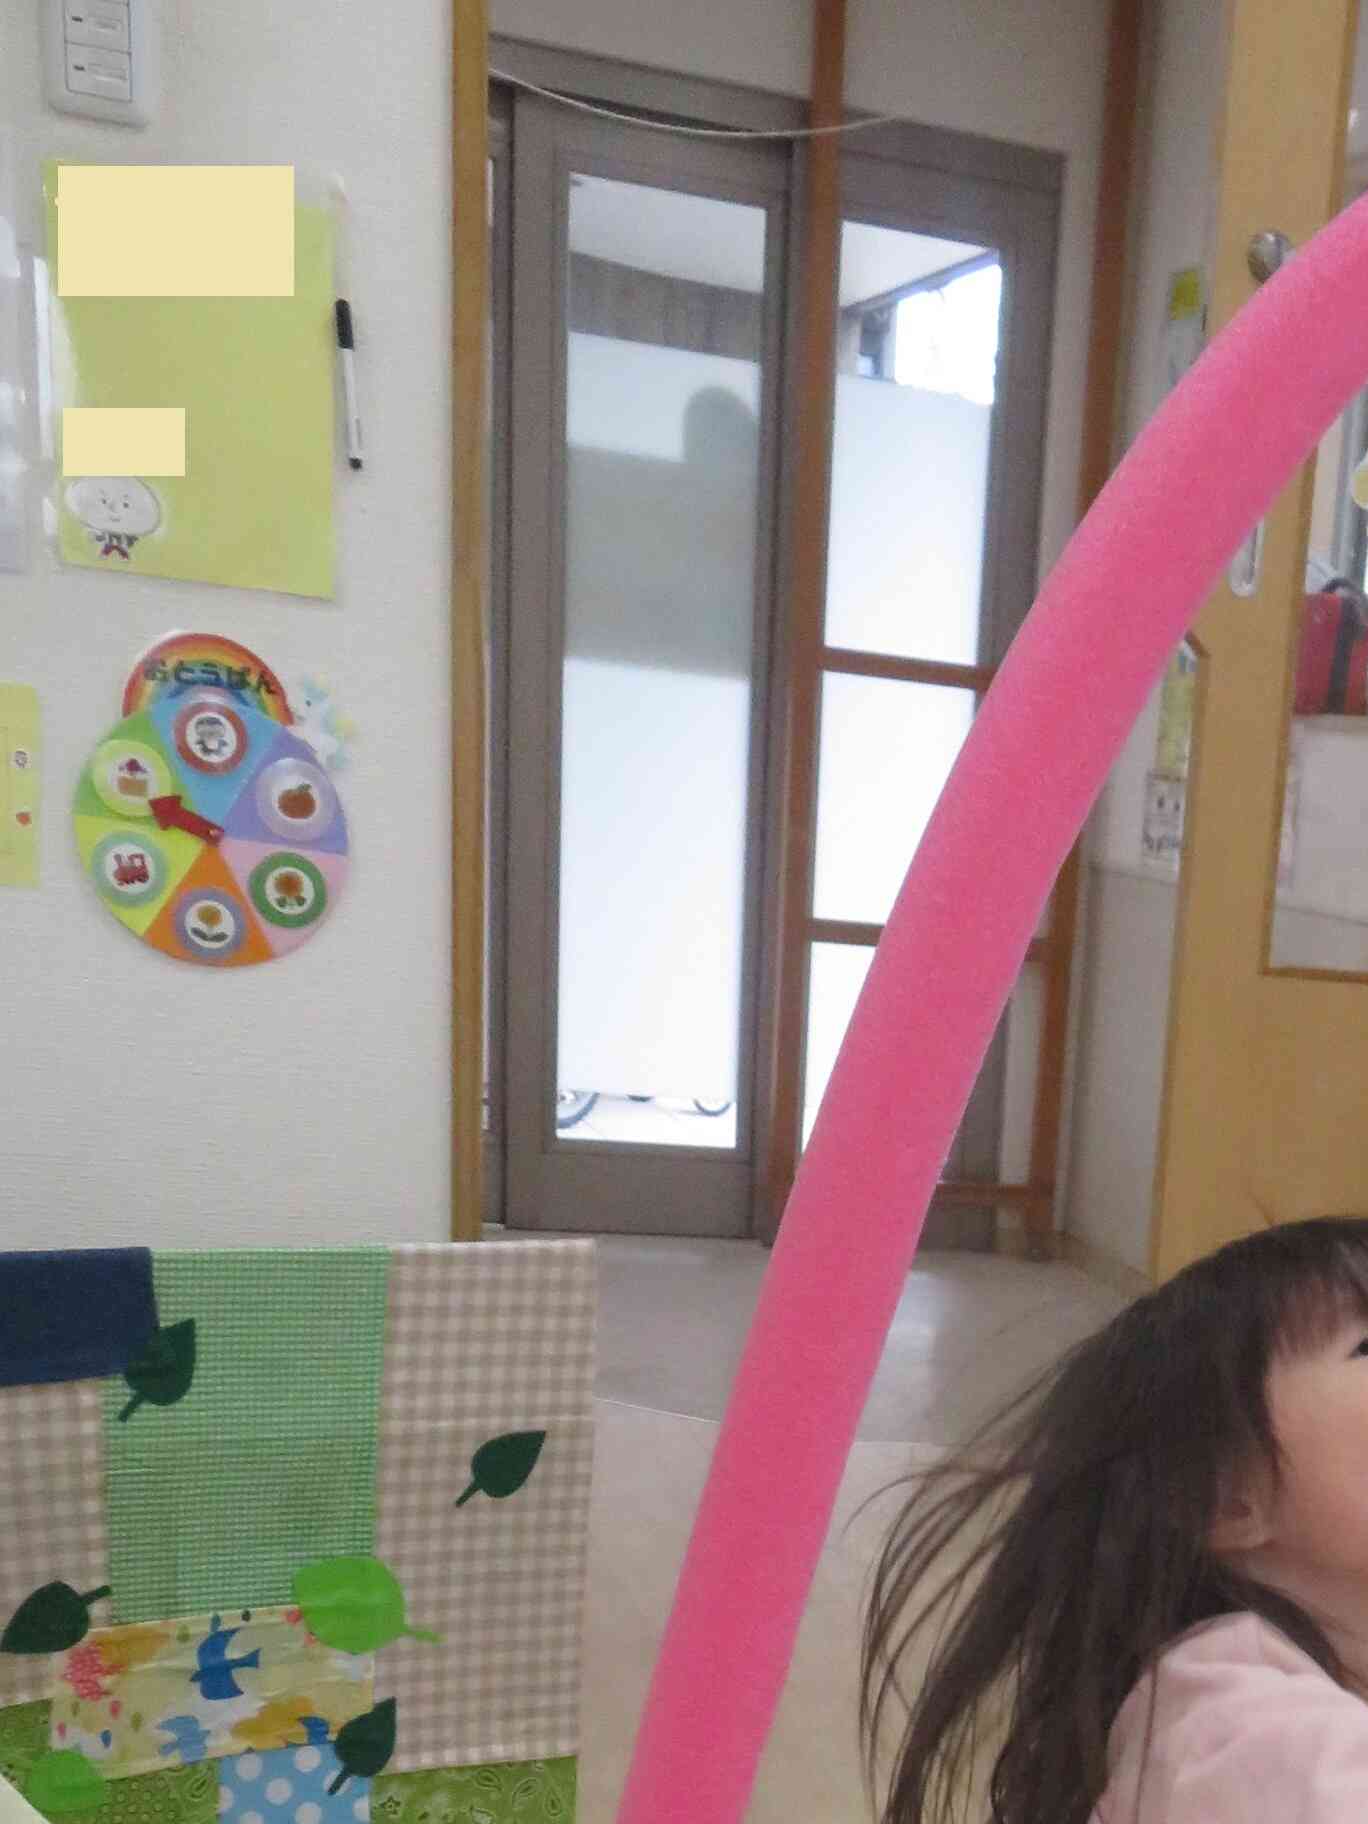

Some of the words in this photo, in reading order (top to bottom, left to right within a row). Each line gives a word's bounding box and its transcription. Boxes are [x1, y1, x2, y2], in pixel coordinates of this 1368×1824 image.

[143, 657, 277, 695] おとうばん
